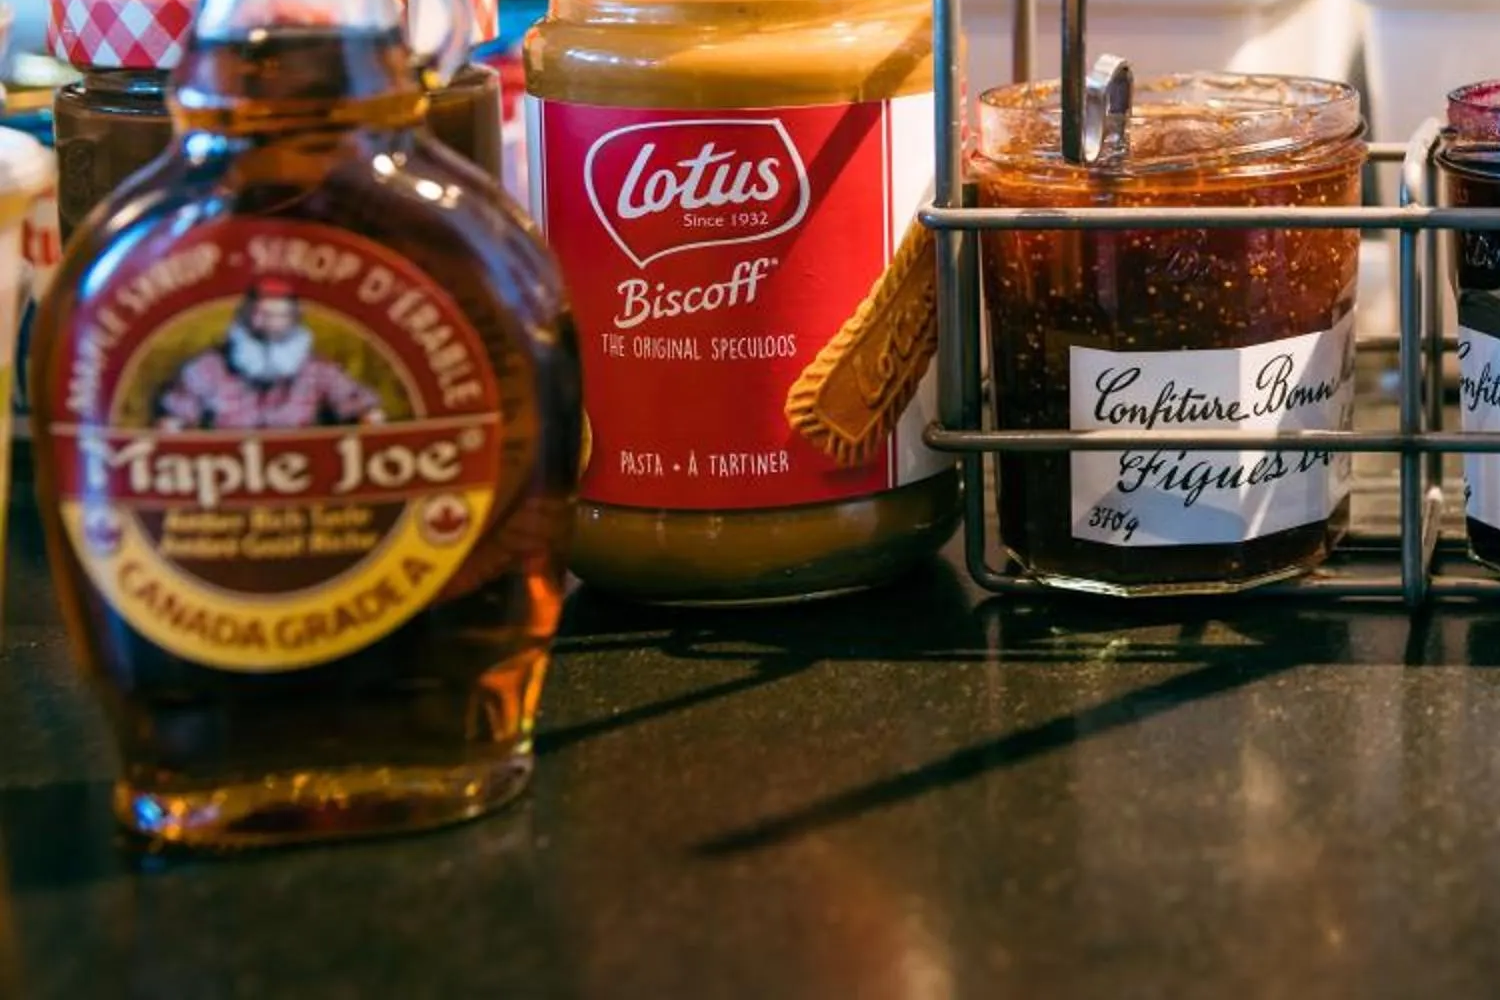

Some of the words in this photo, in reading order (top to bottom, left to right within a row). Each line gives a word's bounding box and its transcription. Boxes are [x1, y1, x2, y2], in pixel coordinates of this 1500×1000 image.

[617, 142, 781, 219] Lotus
[683, 213, 724, 228] Since
[731, 211, 769, 227] 1932
[613, 257, 770, 329] Biscoff
[601, 333, 625, 357] THE
[633, 337, 700, 361] ORIGINAL
[711, 334, 797, 361] SPECULOOS
[1093, 367, 1250, 430] Confiture
[78, 433, 312, 507] Maple
[335, 434, 462, 493] Joe
[620, 450, 663, 476] PASTA
[709, 451, 790, 478] TARTINER
[118, 560, 268, 650] CANADA
[273, 577, 403, 650] GRADE
[402, 556, 435, 588] A
